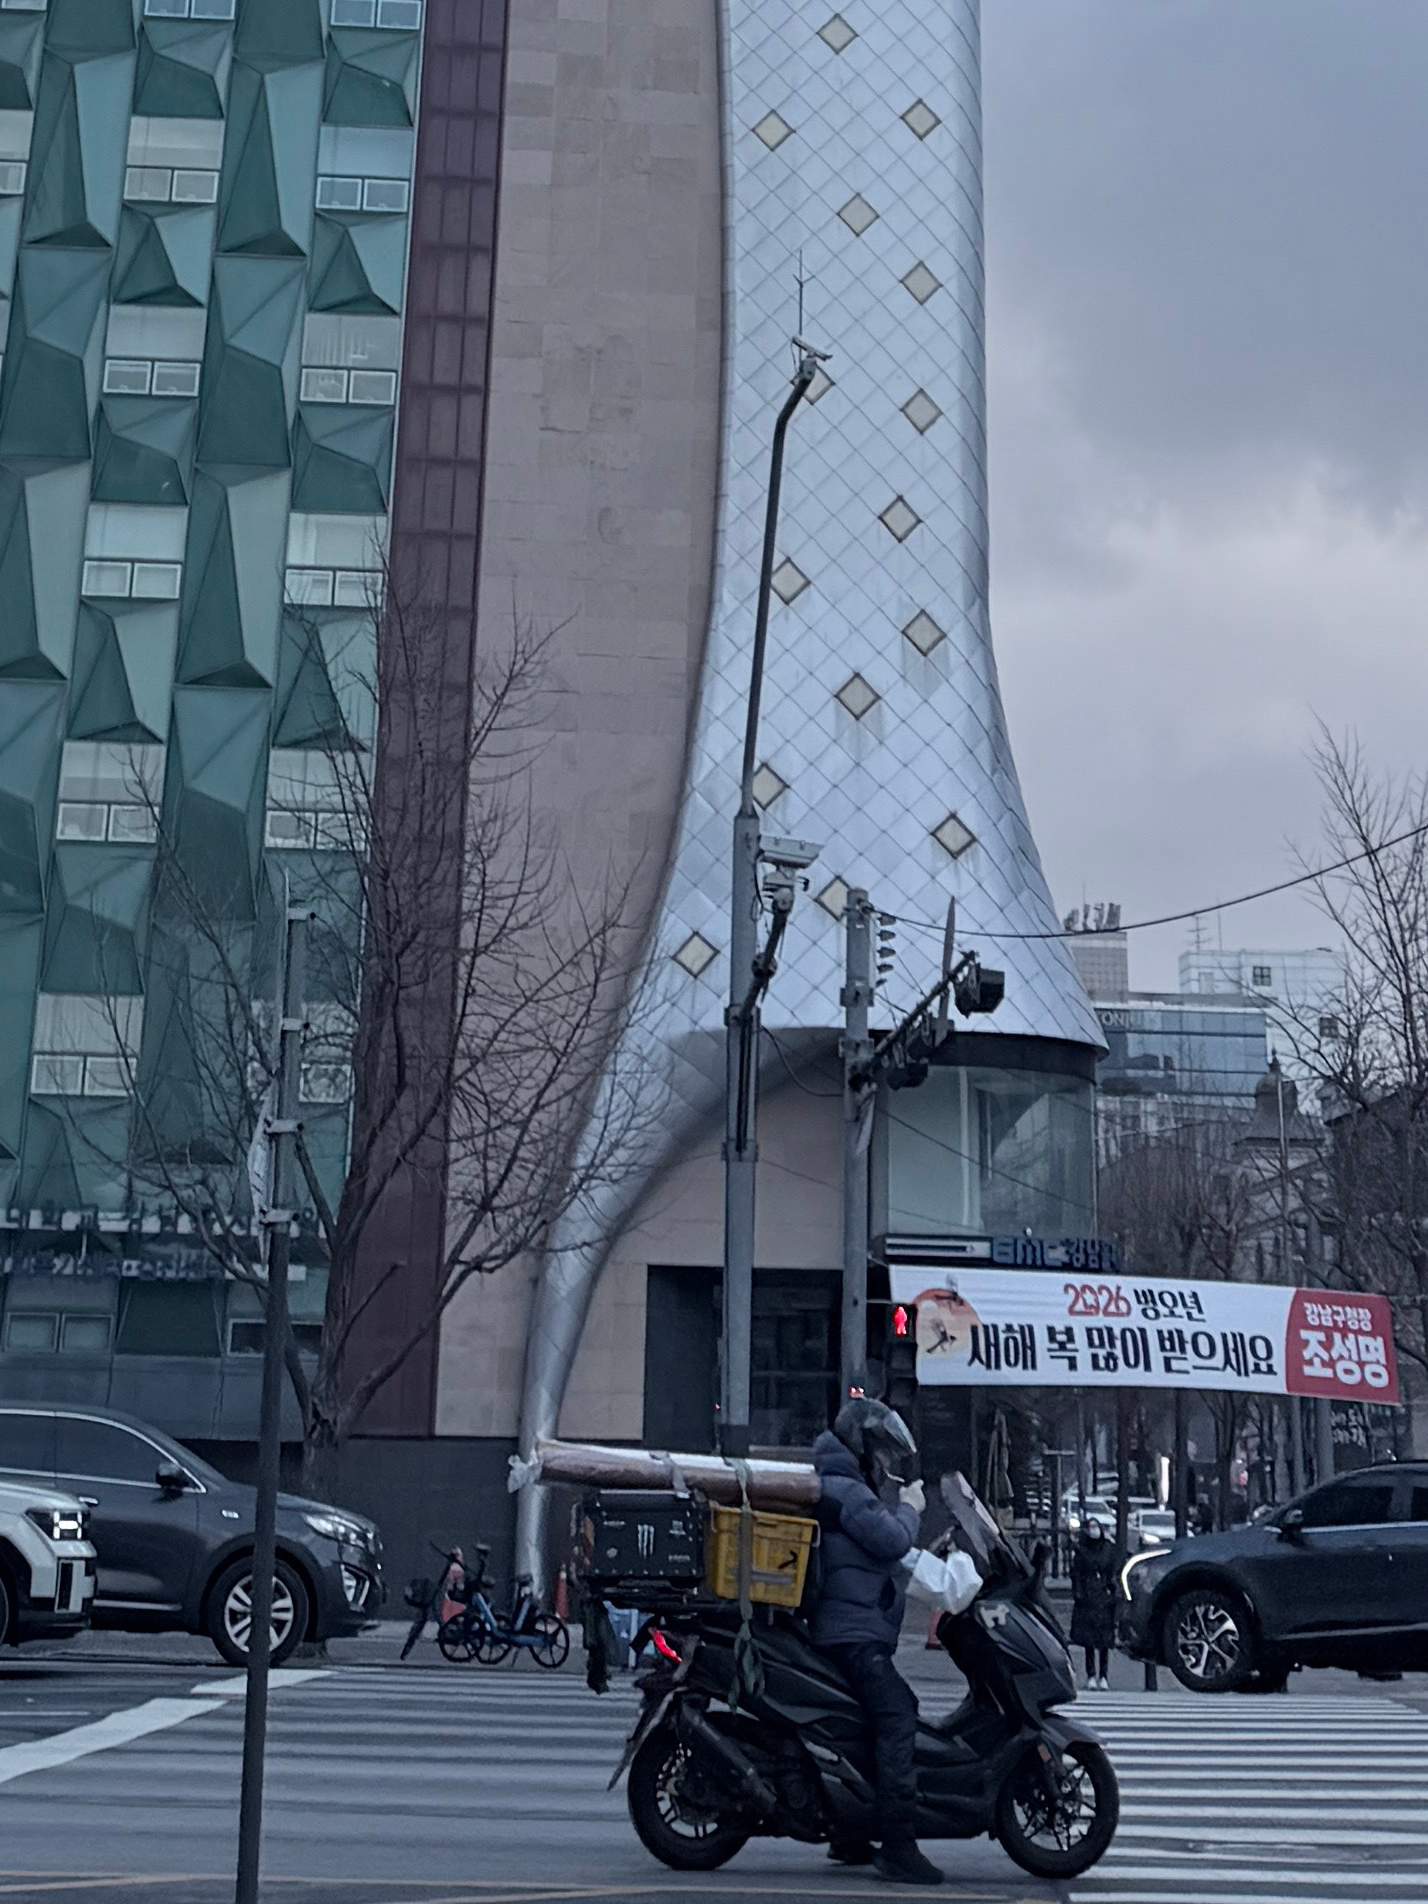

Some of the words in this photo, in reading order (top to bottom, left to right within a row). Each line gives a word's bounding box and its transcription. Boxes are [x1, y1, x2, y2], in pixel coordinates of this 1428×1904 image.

[1063, 1283, 1132, 1318] 2026
[1133, 1288, 1207, 1322] 병오년
[1303, 1302, 1372, 1332] 강남구청장
[967, 1323, 1038, 1372] 새해
[1046, 1325, 1079, 1372] 복
[1085, 1325, 1152, 1373] 많이
[1158, 1328, 1278, 1379] 받으세요
[1299, 1329, 1390, 1389] 조성명
